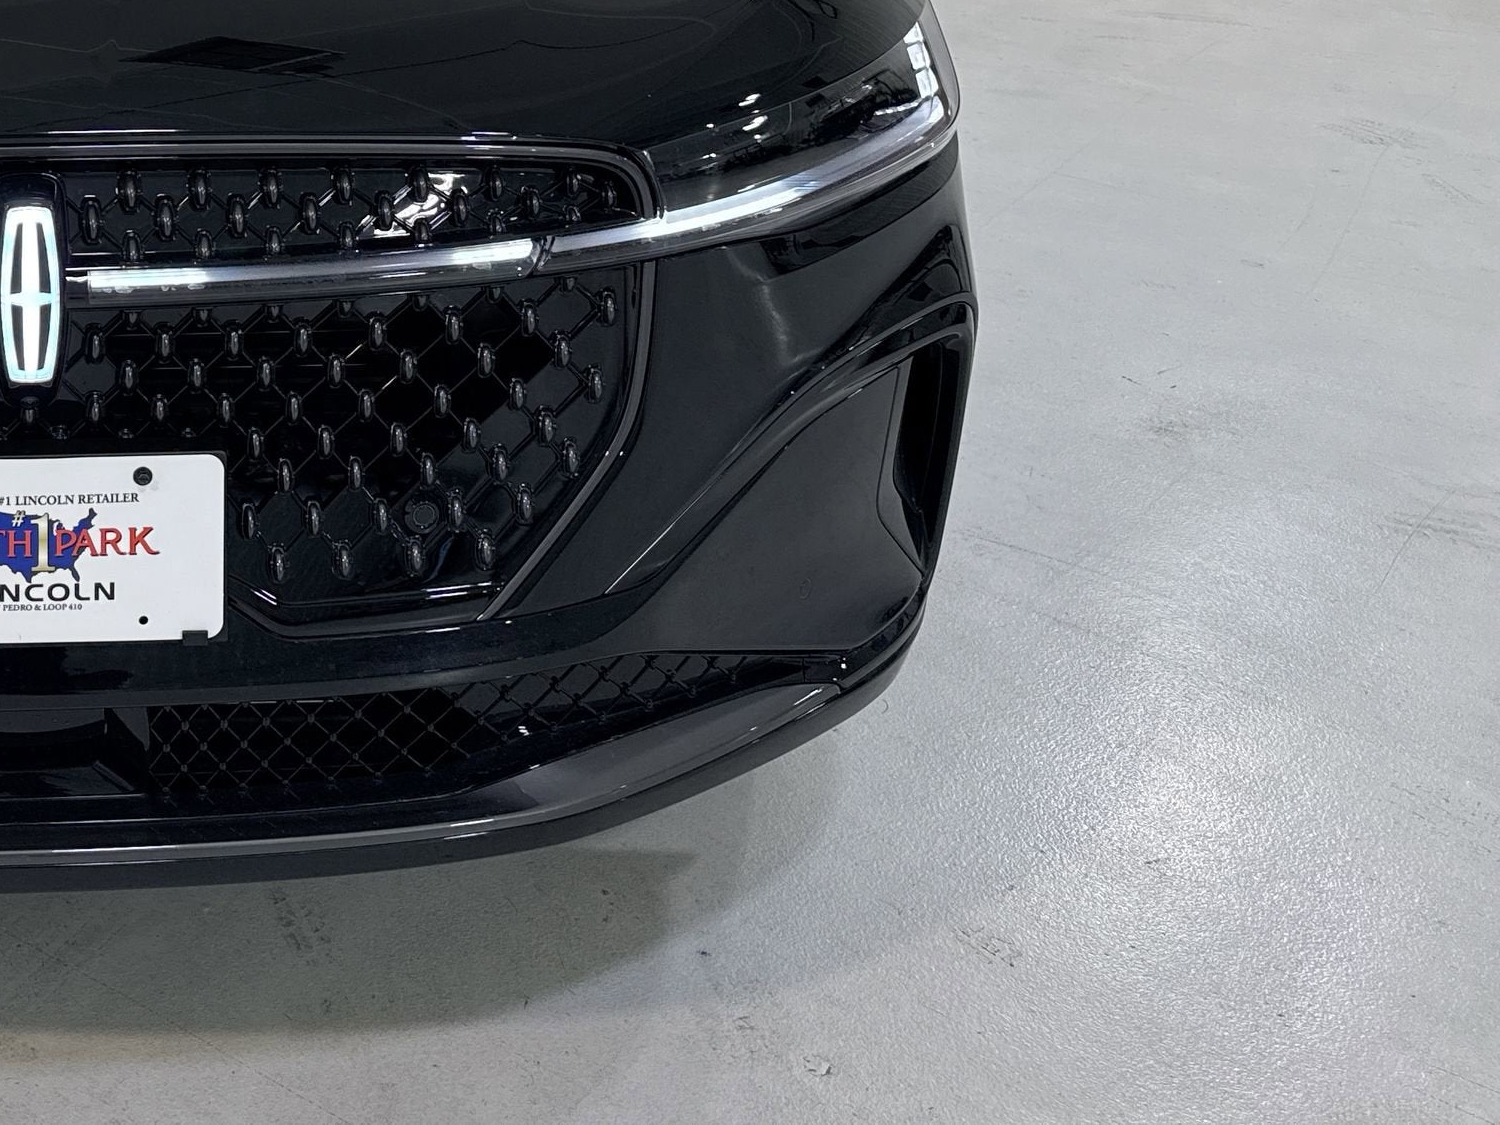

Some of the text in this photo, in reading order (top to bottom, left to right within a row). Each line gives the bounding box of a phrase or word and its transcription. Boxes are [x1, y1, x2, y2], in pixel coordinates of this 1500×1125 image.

[15, 494, 75, 506] LINCOLN
[78, 492, 140, 505] RETAILER
[55, 527, 160, 557] PARK
[2, 603, 33, 612] PEDRO
[34, 603, 42, 612] &
[43, 603, 68, 612] LOOP
[68, 602, 83, 611] 410
